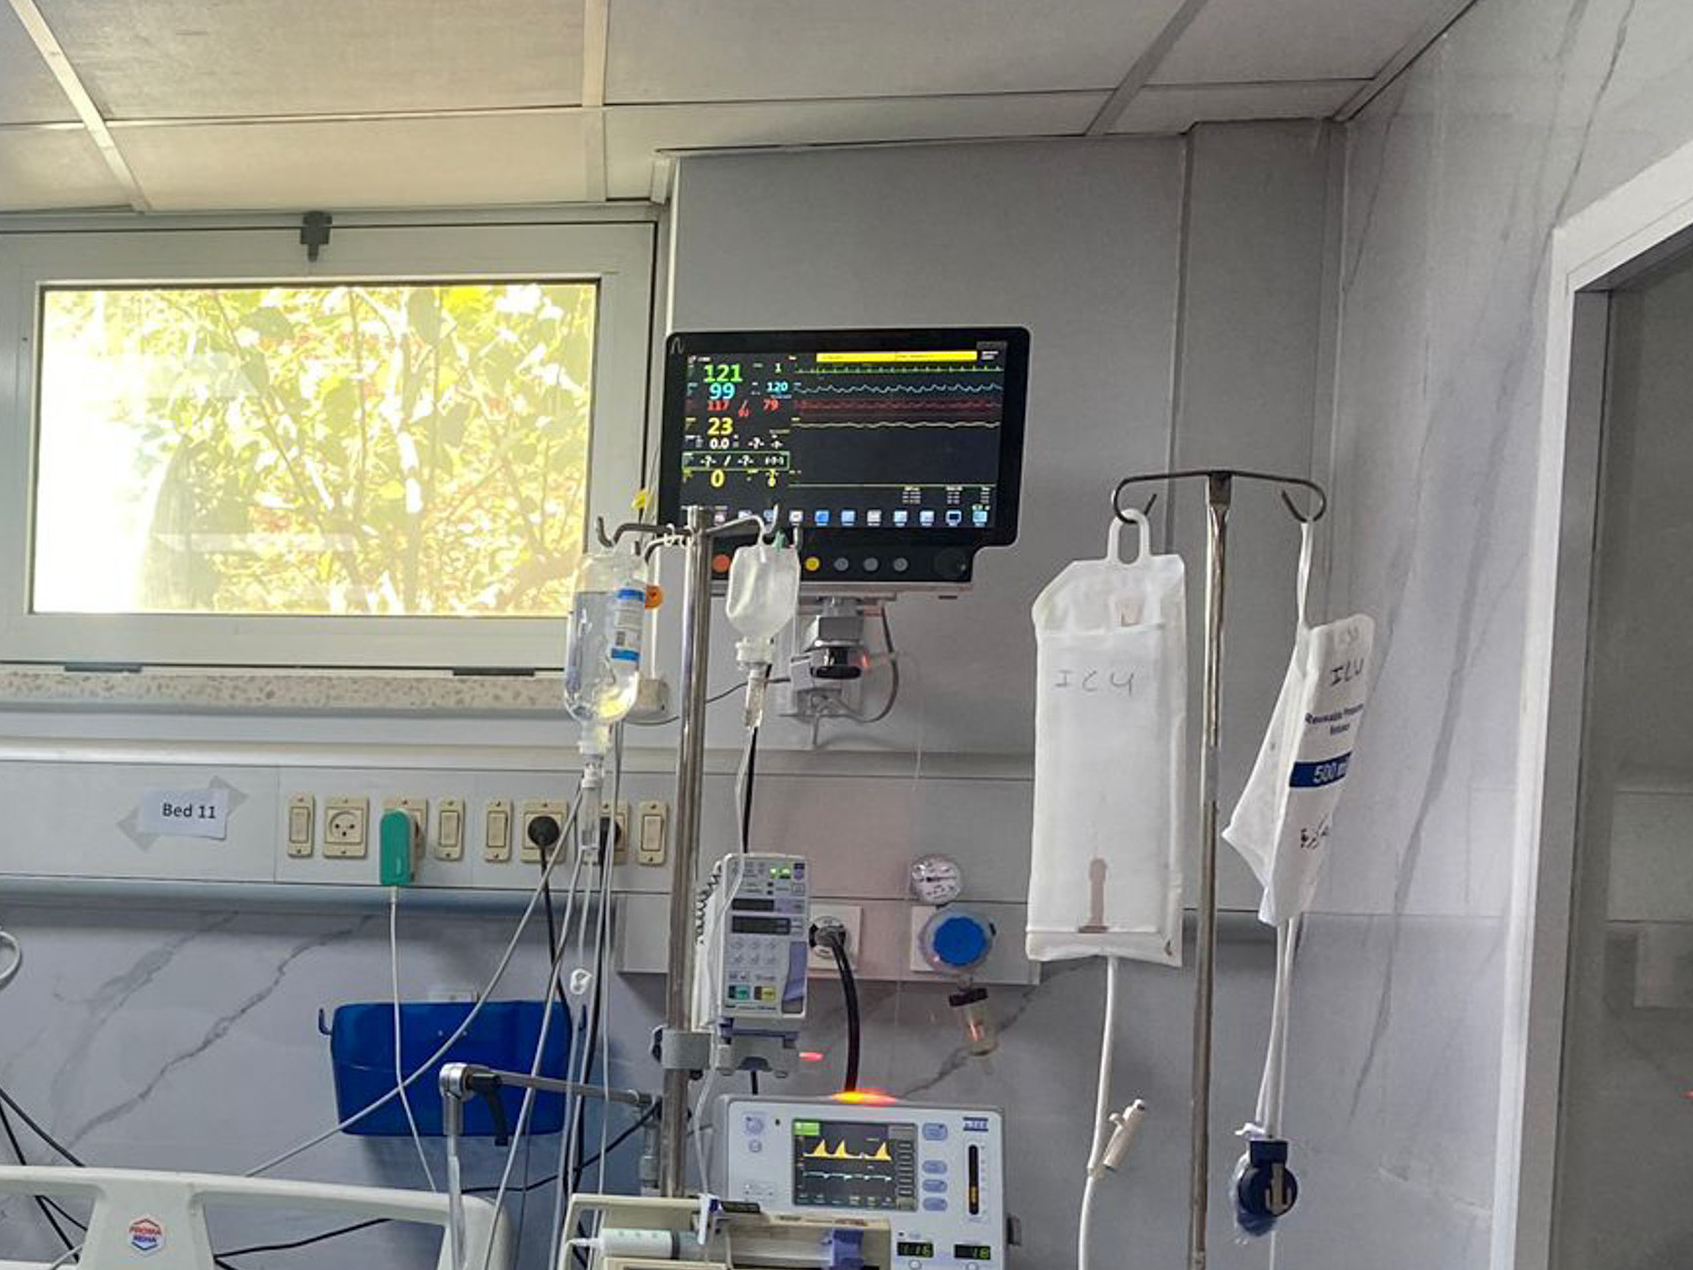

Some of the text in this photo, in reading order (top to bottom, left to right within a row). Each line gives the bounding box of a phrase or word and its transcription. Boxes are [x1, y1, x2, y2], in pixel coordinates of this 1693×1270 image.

[704, 364, 743, 382] 121
[710, 382, 788, 400] 99 120
[708, 417, 733, 435] 23
[711, 469, 725, 487] 0
[162, 802, 216, 819] Bed 11
